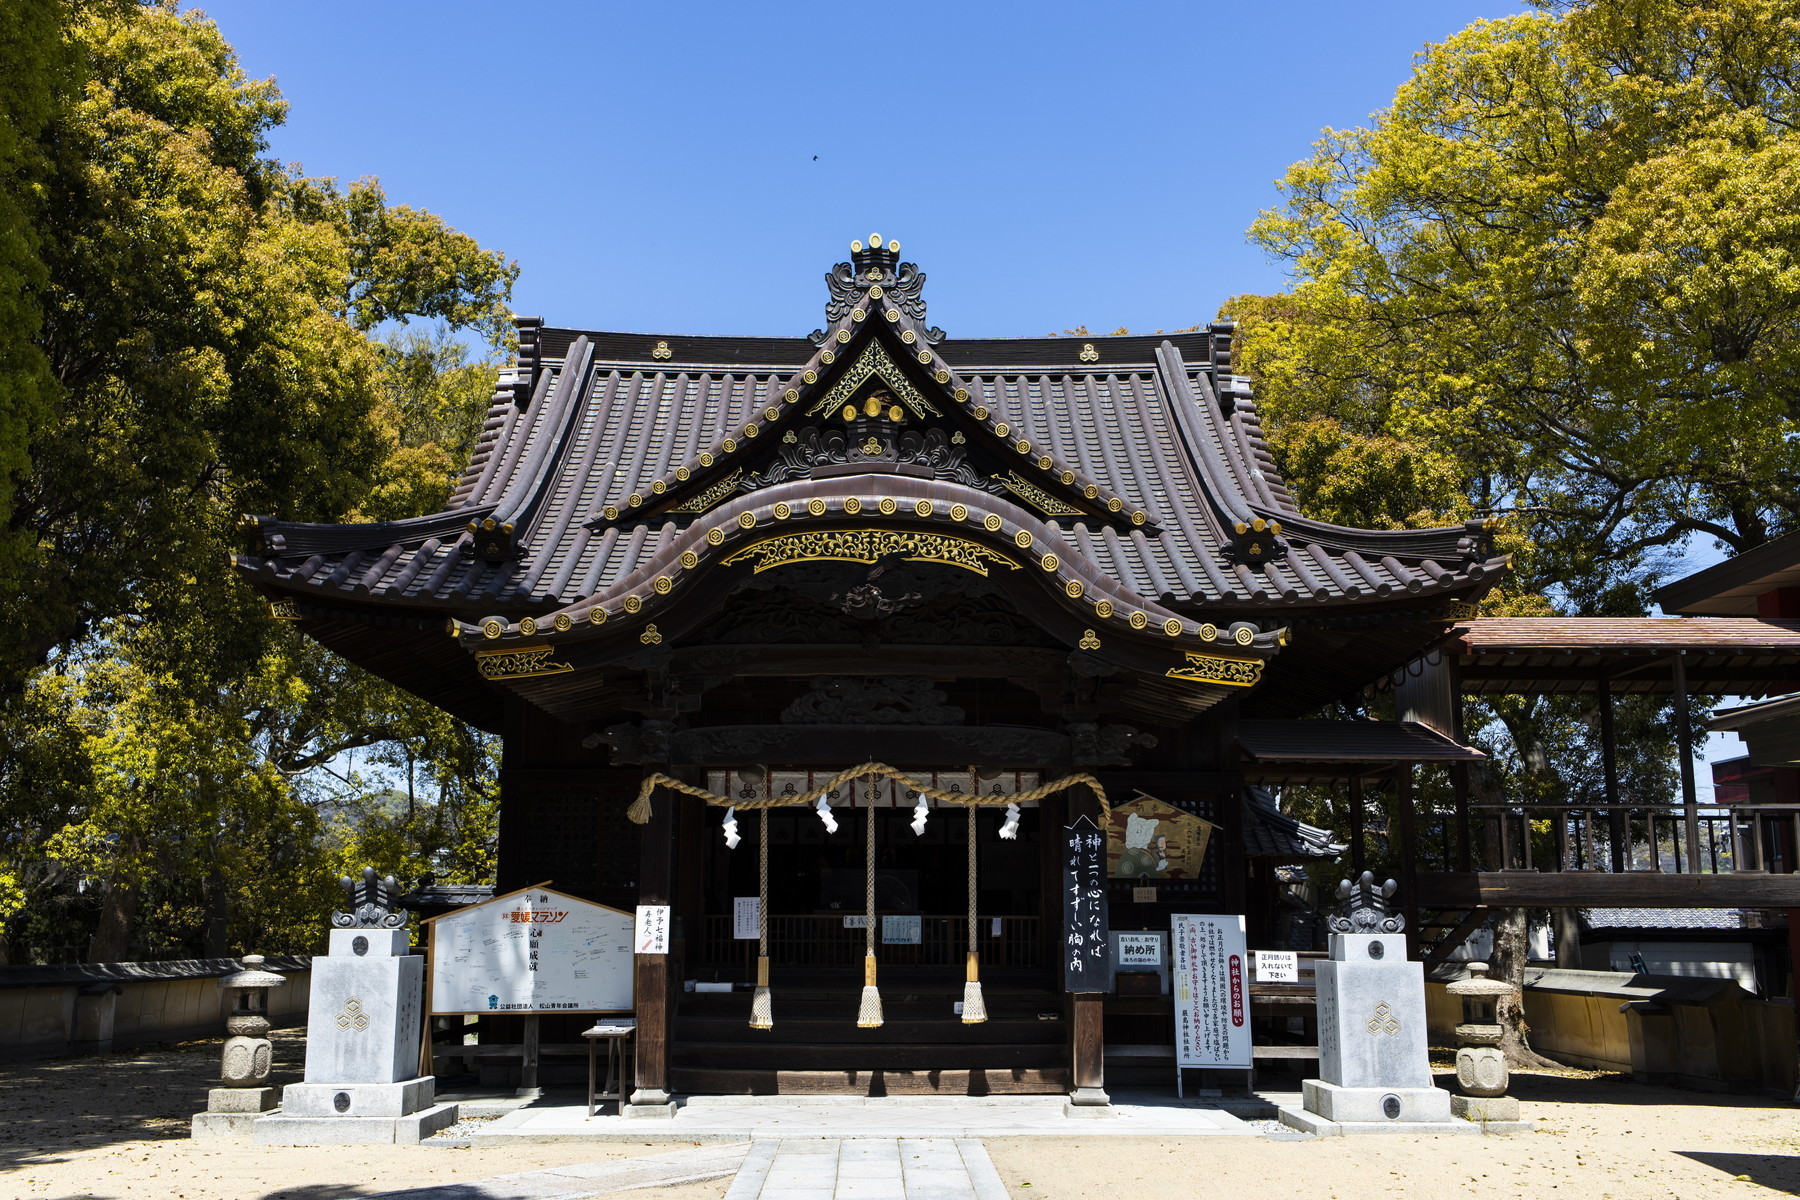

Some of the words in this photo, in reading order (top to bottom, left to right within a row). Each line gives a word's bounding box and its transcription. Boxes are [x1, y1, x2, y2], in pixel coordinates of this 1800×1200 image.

[1085, 833, 1106, 958] 神と一つの心になれば
[1068, 833, 1085, 973] 晴れてすずしい胸の内
[511, 911, 570, 924] 愛媛マラソン
[655, 908, 664, 952] 伊予七福神
[529, 928, 540, 973] 心願成就
[1124, 944, 1155, 956] 納め所
[1261, 953, 1291, 961] 正月飾りは
[1261, 962, 1292, 970] 入れないで
[1268, 971, 1287, 979] 下さい
[1230, 958, 1243, 1024] 神社からのお願い
[499, 1002, 534, 1010] 公益社団法人
[539, 1002, 579, 1010] 松山青年会議所
